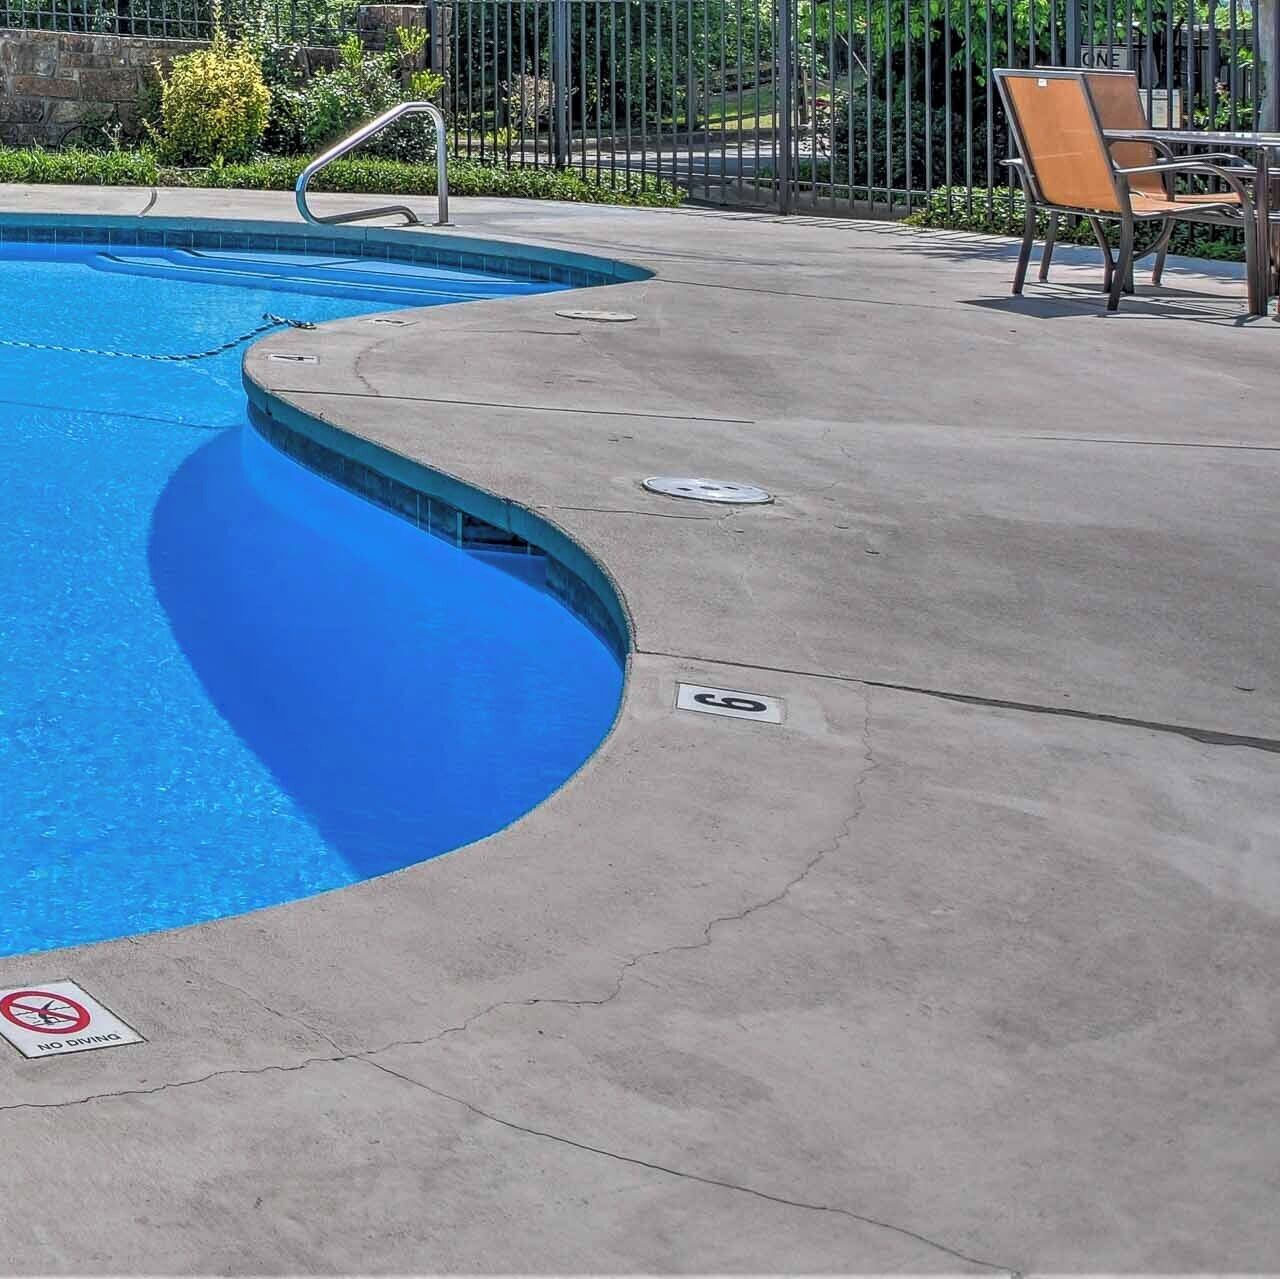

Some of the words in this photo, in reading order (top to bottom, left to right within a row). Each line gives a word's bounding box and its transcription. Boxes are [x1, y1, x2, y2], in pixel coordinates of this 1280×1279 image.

[694, 694, 767, 712] 6
[38, 1041, 63, 1052] NO
[66, 1034, 121, 1046] DIVING
